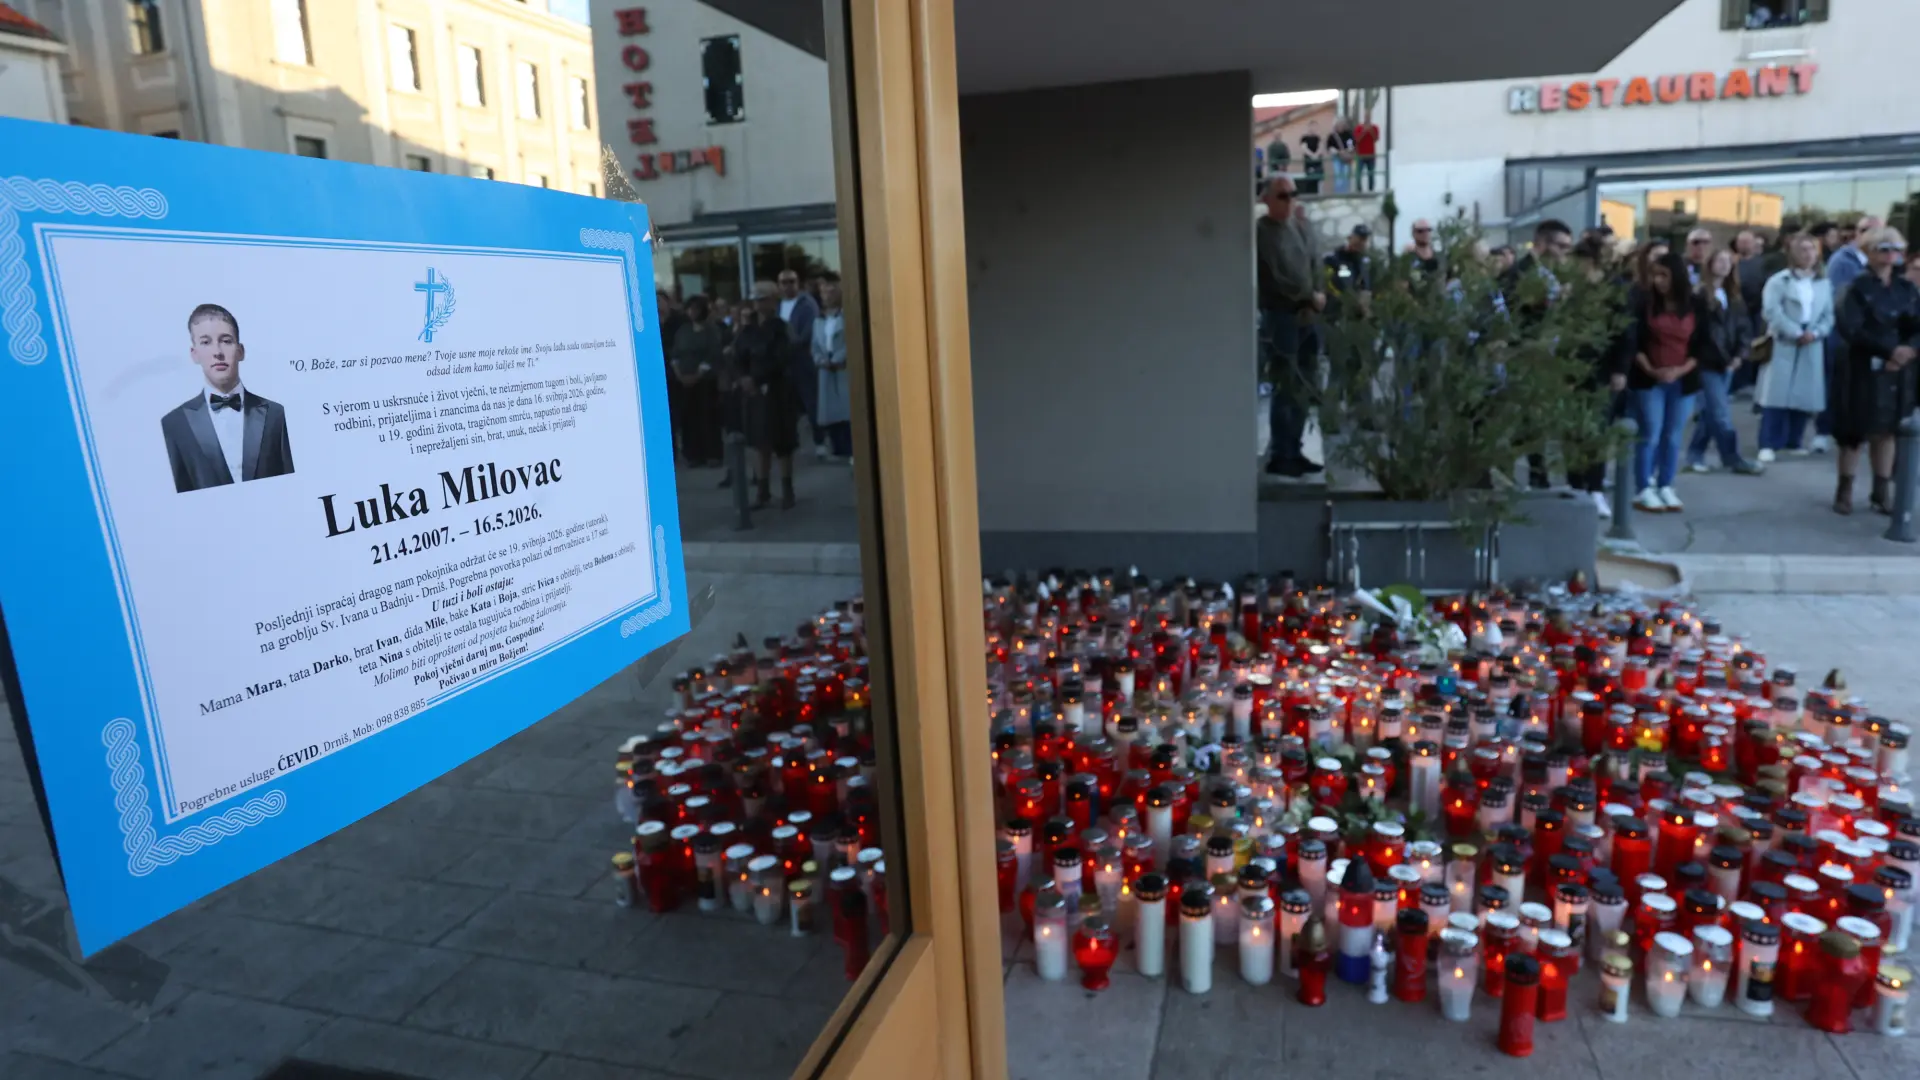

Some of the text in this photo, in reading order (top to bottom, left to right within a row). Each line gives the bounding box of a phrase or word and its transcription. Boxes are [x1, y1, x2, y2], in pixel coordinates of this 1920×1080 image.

[1508, 63, 1818, 114] RESTAURANT
[290, 360, 307, 372] "O,
[311, 358, 338, 370] Bože,
[342, 358, 357, 368] zar
[360, 356, 368, 366] si
[370, 355, 402, 368] pozvao
[405, 351, 431, 363] mene?
[435, 350, 456, 362] Tvoje
[459, 350, 476, 358] usne
[478, 348, 496, 360] moje
[498, 345, 518, 356] rekoše
[535, 344, 552, 354] Svoju
[554, 342, 566, 351] lađu
[567, 342, 579, 350] sada
[427, 365, 450, 376] odsad
[453, 363, 471, 374] idem
[474, 360, 493, 372] kamo
[495, 358, 514, 371] šalješ
[527, 358, 538, 367] Ti."
[323, 402, 330, 415] S
[333, 400, 370, 416] vjerom
[373, 400, 379, 408] u
[382, 393, 428, 407] uskrsnuće
[437, 390, 458, 401] život
[461, 385, 488, 400] vječni,
[490, 385, 497, 394] te
[499, 380, 544, 393] neizmjernom
[545, 378, 564, 389] tugom
[570, 374, 583, 385] boli,
[584, 373, 607, 385] javljamo
[334, 416, 375, 431] rodbini,
[378, 409, 431, 428] prijateljima
[440, 404, 479, 417] znancima
[482, 400, 491, 411] da
[493, 400, 506, 410] nas
[508, 398, 514, 411] je
[516, 395, 532, 406] dana
[534, 394, 544, 404] 16.
[546, 390, 568, 403] svibnja
[569, 388, 584, 399] 2026.
[586, 386, 606, 398] godine,
[379, 401, 588, 442] u 19. godini života, tragičnom smrću, napustio naš dragi
[410, 444, 414, 454] i
[416, 436, 468, 454] neprežaljeni
[471, 432, 485, 444] sin,
[487, 429, 505, 441] brat,
[506, 426, 526, 438] unuk,
[529, 420, 547, 434] nećak
[552, 417, 576, 432] prijatelj
[318, 458, 562, 538] Luka Milovac
[371, 526, 455, 564] 21.4.2007.
[474, 504, 542, 536] 16.5.2026.
[255, 607, 313, 635] Posljednji
[316, 592, 356, 616] ispraćaj
[358, 584, 393, 601] dragog
[395, 576, 414, 590] nam
[416, 561, 458, 585] pokojnika
[460, 554, 486, 569] održat
[488, 550, 496, 560] će
[498, 549, 506, 558] se
[509, 543, 520, 554] 19.
[521, 535, 546, 550] svibnja
[548, 530, 564, 543] 2026.
[566, 524, 584, 538] godine
[260, 641, 274, 653] na
[279, 625, 318, 650] groblju
[320, 620, 338, 632] Sv.
[340, 609, 369, 626] Ivana
[371, 606, 378, 615] u
[380, 594, 414, 612] Badnju
[450, 570, 488, 589] Pogrebna
[490, 559, 520, 578] povorka
[522, 552, 542, 567] polazi
[544, 545, 552, 557] od
[554, 538, 585, 554] mrtvačnice
[591, 532, 598, 541] 17
[599, 528, 609, 536] sati.
[432, 600, 442, 612] U
[443, 594, 458, 608] tuzi
[466, 586, 483, 600] boli
[485, 576, 514, 594] ostaju:
[200, 694, 242, 716] Mama
[246, 679, 286, 700] Mara,
[289, 670, 310, 685] tata
[312, 653, 352, 674] Darko,
[354, 644, 374, 658] brat
[375, 635, 402, 650] Ivan,
[404, 624, 423, 640] dida
[425, 615, 448, 632] Mile,
[449, 608, 468, 622] bake
[470, 600, 491, 613] Kata
[498, 591, 520, 607] Boja,
[521, 583, 536, 596] stric
[537, 577, 554, 589] Ivica
[561, 568, 582, 582] obitelji,
[583, 562, 593, 571] teta
[594, 553, 614, 567] Božena
[359, 660, 377, 674] teta
[379, 650, 403, 665] Nina
[413, 632, 443, 653] obitelji
[445, 630, 452, 640] te
[453, 620, 477, 635] ostala
[478, 607, 512, 630] tugujuća
[513, 596, 540, 612] rodbina
[545, 583, 572, 601] prijatelji.
[374, 600, 567, 687] Molimo biti oprošteni od posjeta kućnog žalovanju.
[414, 622, 545, 686] Pokoj vječni daruj mu, Gospodine!
[439, 671, 470, 690] Počivao
[479, 658, 497, 672] miru
[498, 644, 528, 666] Božjem!
[180, 698, 426, 813] Pogrebne usluge ĆEVID, Drniš, Mob: 098 838 885
